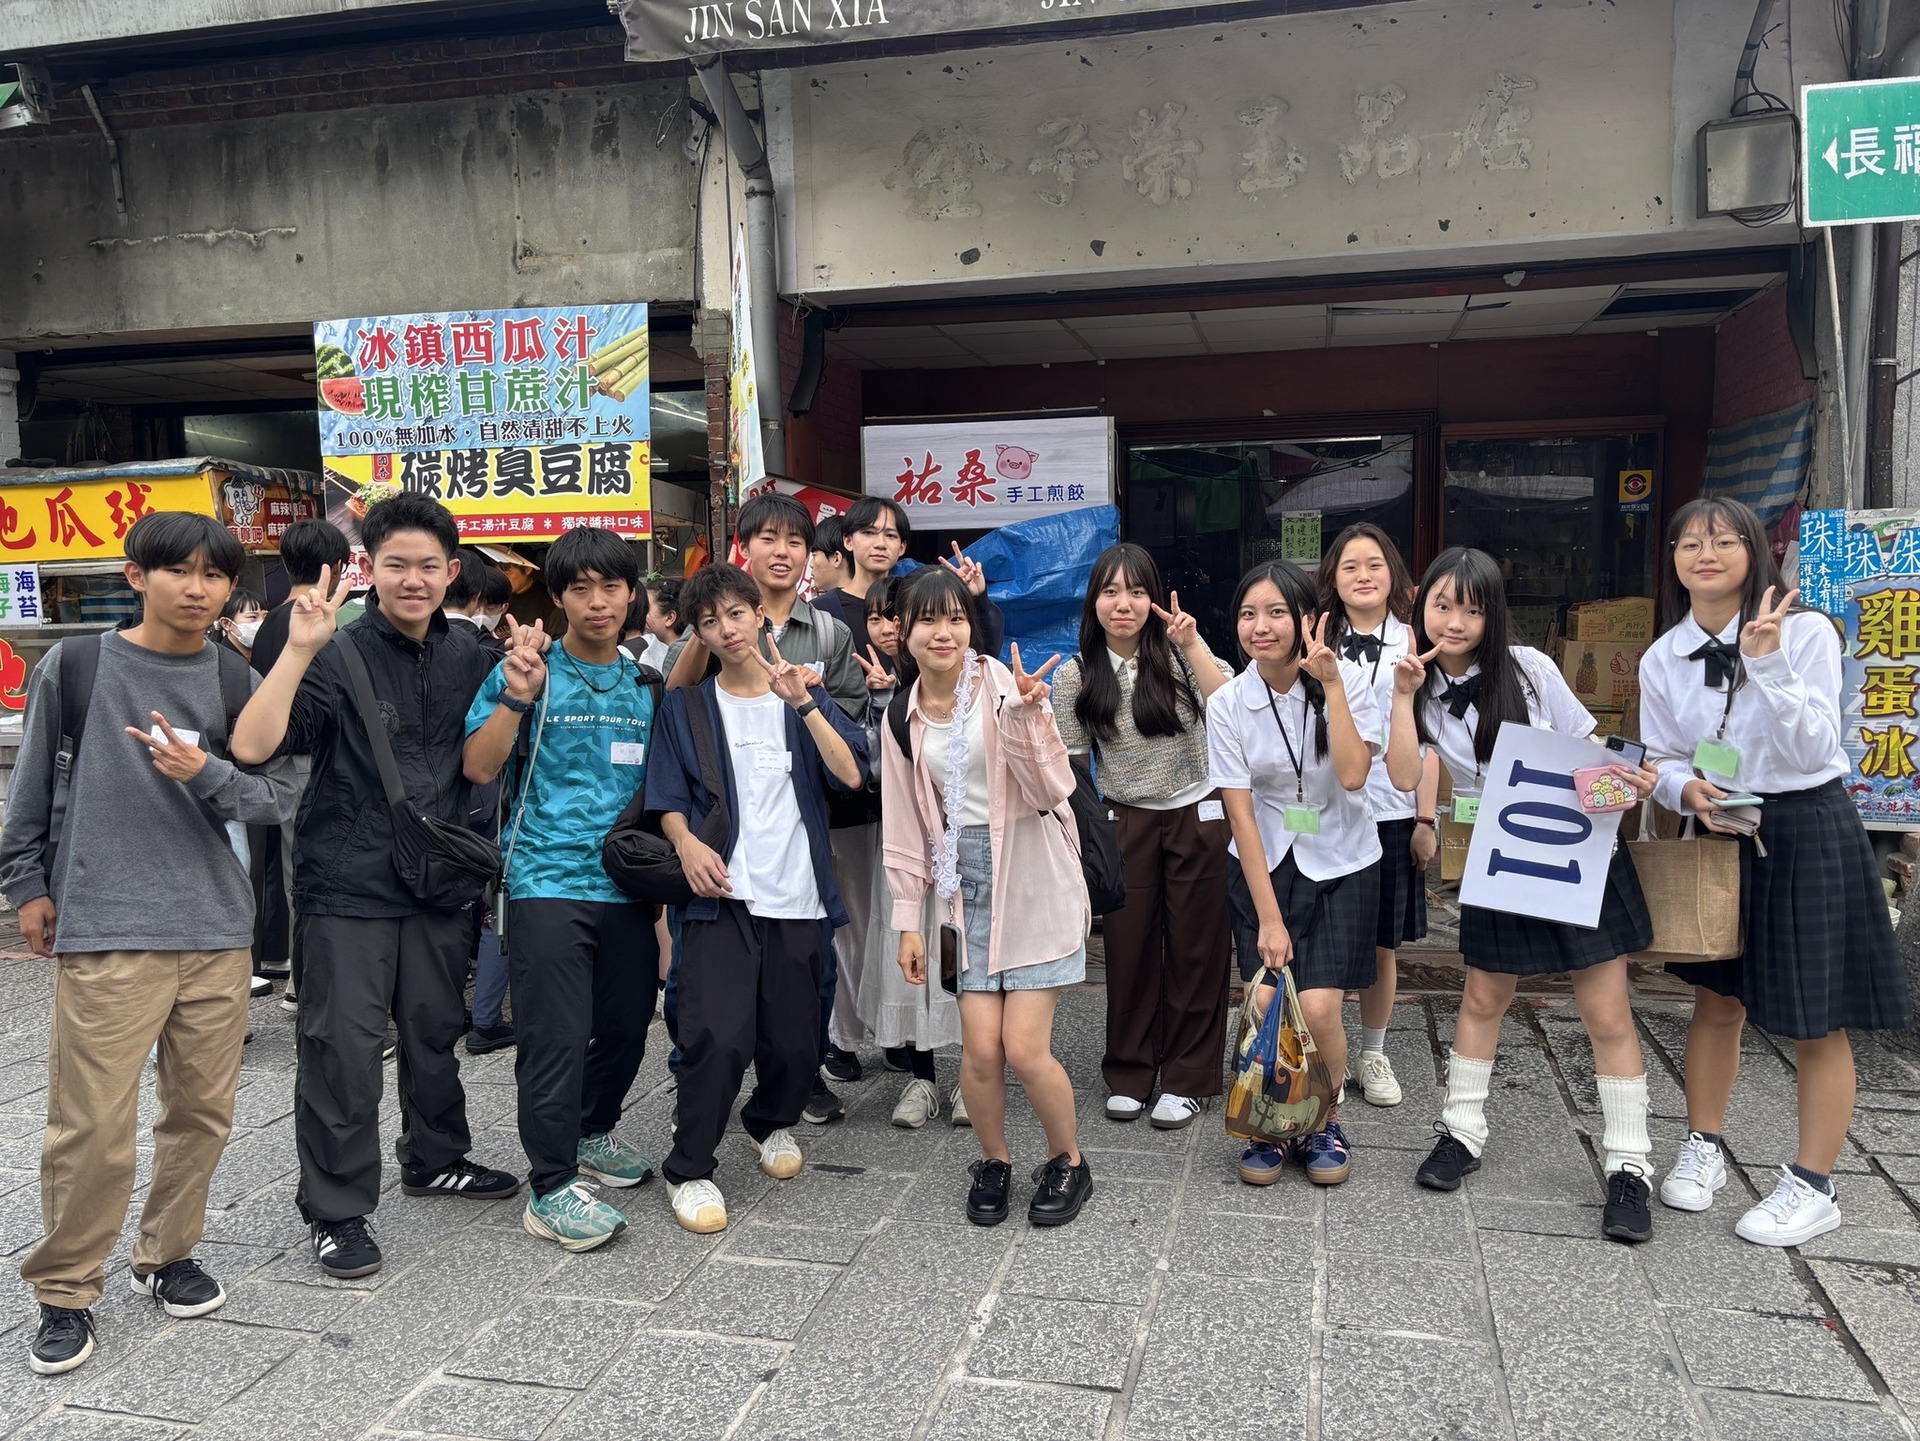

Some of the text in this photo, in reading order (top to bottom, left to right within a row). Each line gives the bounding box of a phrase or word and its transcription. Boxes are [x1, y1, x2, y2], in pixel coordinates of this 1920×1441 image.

[684, 0, 890, 43] JIN SAN XIA
[356, 315, 598, 371] 冰鎮西瓜汁
[361, 365, 600, 420] 現榨甘蔗汁
[400, 443, 634, 499] 碳烤臭豆腐
[892, 448, 997, 508] 祐桑
[1006, 483, 1085, 503] 手工煎餃
[15, 570, 38, 618] 海苔
[1853, 587, 1920, 778] 雞蛋冰
[546, 715, 560, 723] LE
[599, 715, 622, 724] POUR
[626, 718, 647, 727] TOUS
[1487, 759, 1592, 885] 101
